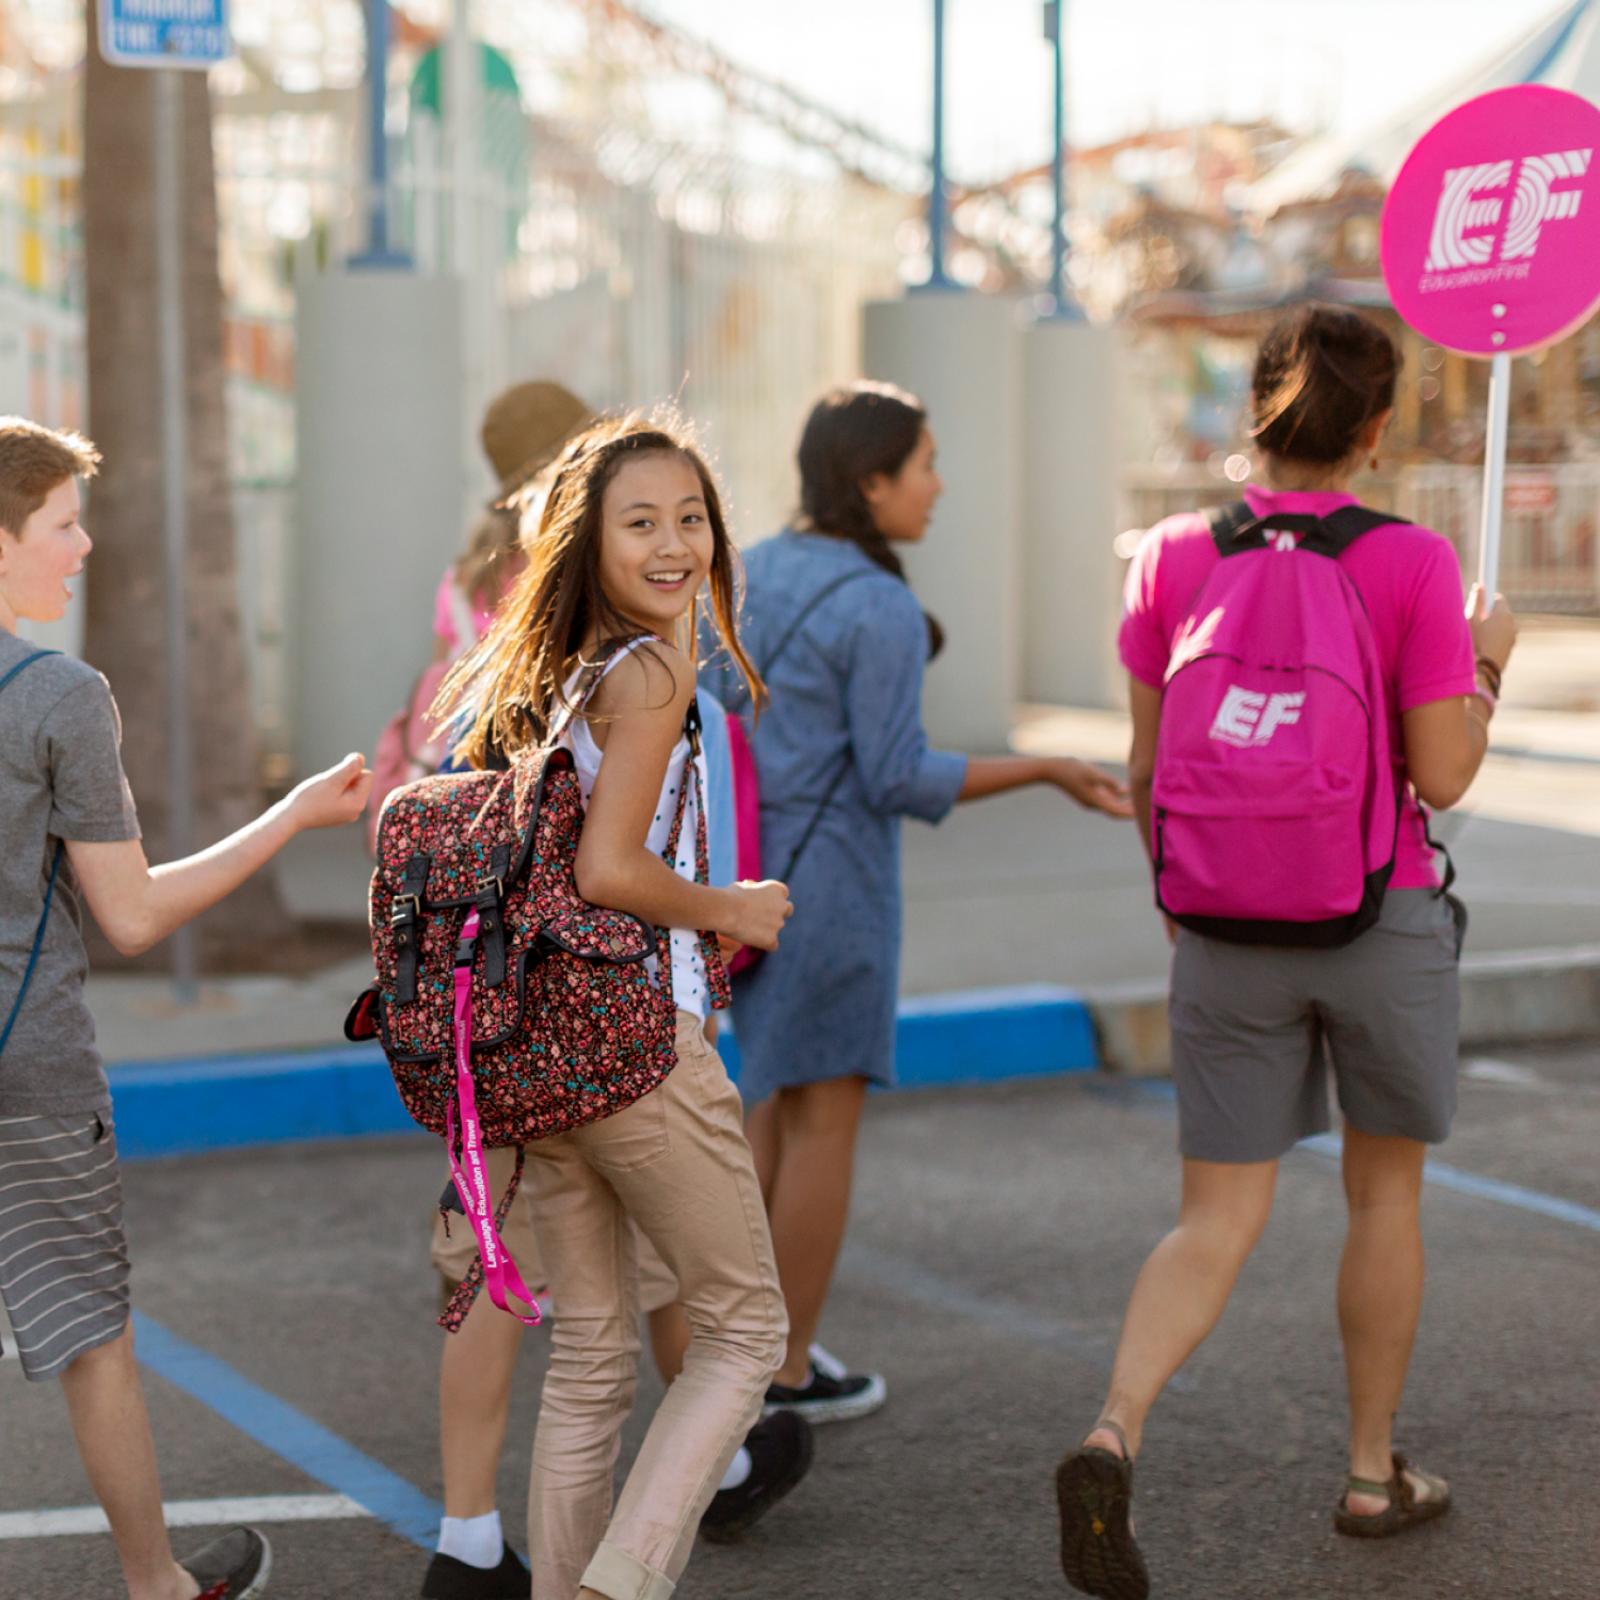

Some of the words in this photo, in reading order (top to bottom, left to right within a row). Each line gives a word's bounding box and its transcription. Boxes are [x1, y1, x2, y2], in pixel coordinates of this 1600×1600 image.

[1424, 148, 1593, 273] EF
[1213, 683, 1307, 740] EF
[466, 1118, 477, 1149] Travel
[467, 1150, 480, 1166] and
[454, 1172, 475, 1214] Educati
[473, 1166, 487, 1216] Education
[480, 1217, 497, 1268] Language,
